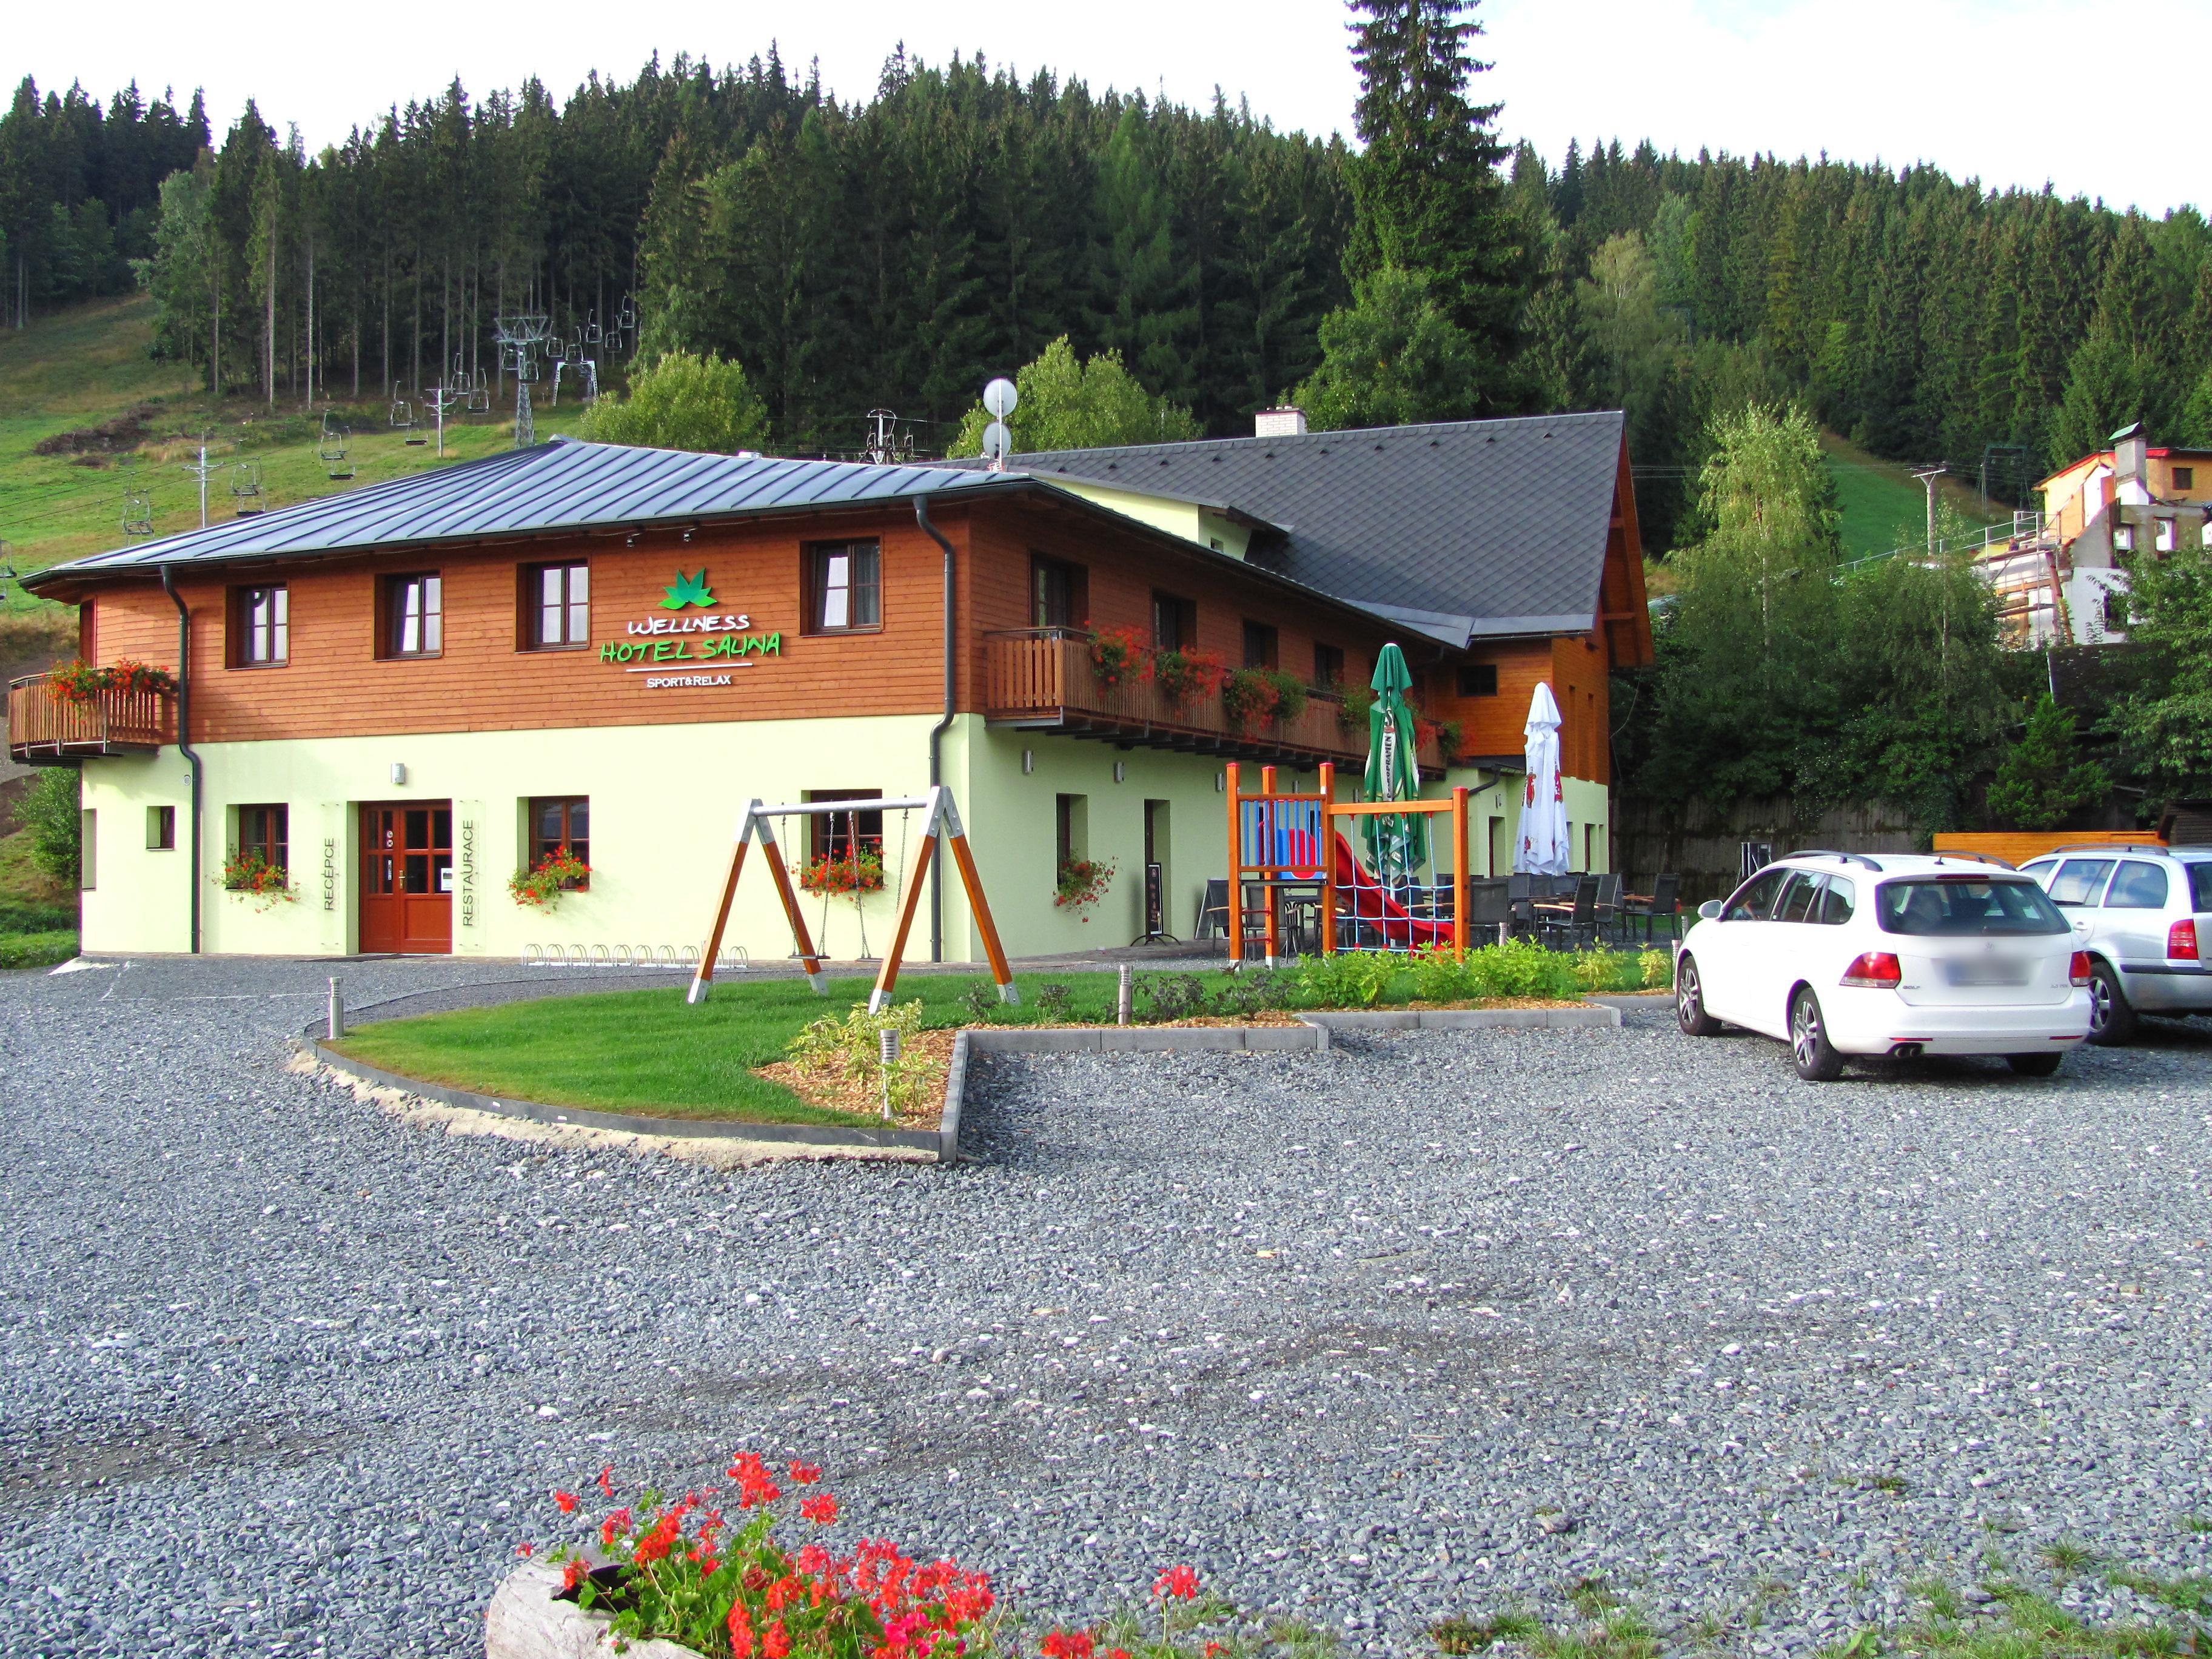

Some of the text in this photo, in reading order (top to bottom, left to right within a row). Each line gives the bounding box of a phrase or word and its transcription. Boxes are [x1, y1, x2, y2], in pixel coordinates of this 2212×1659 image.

[628, 615, 750, 635] WELLNESS
[600, 632, 781, 663] HOTEL SAUNA
[646, 675, 731, 688] SPORT&RELAX
[324, 838, 334, 910] RECEPCE
[463, 820, 474, 927] RESTAURACE
